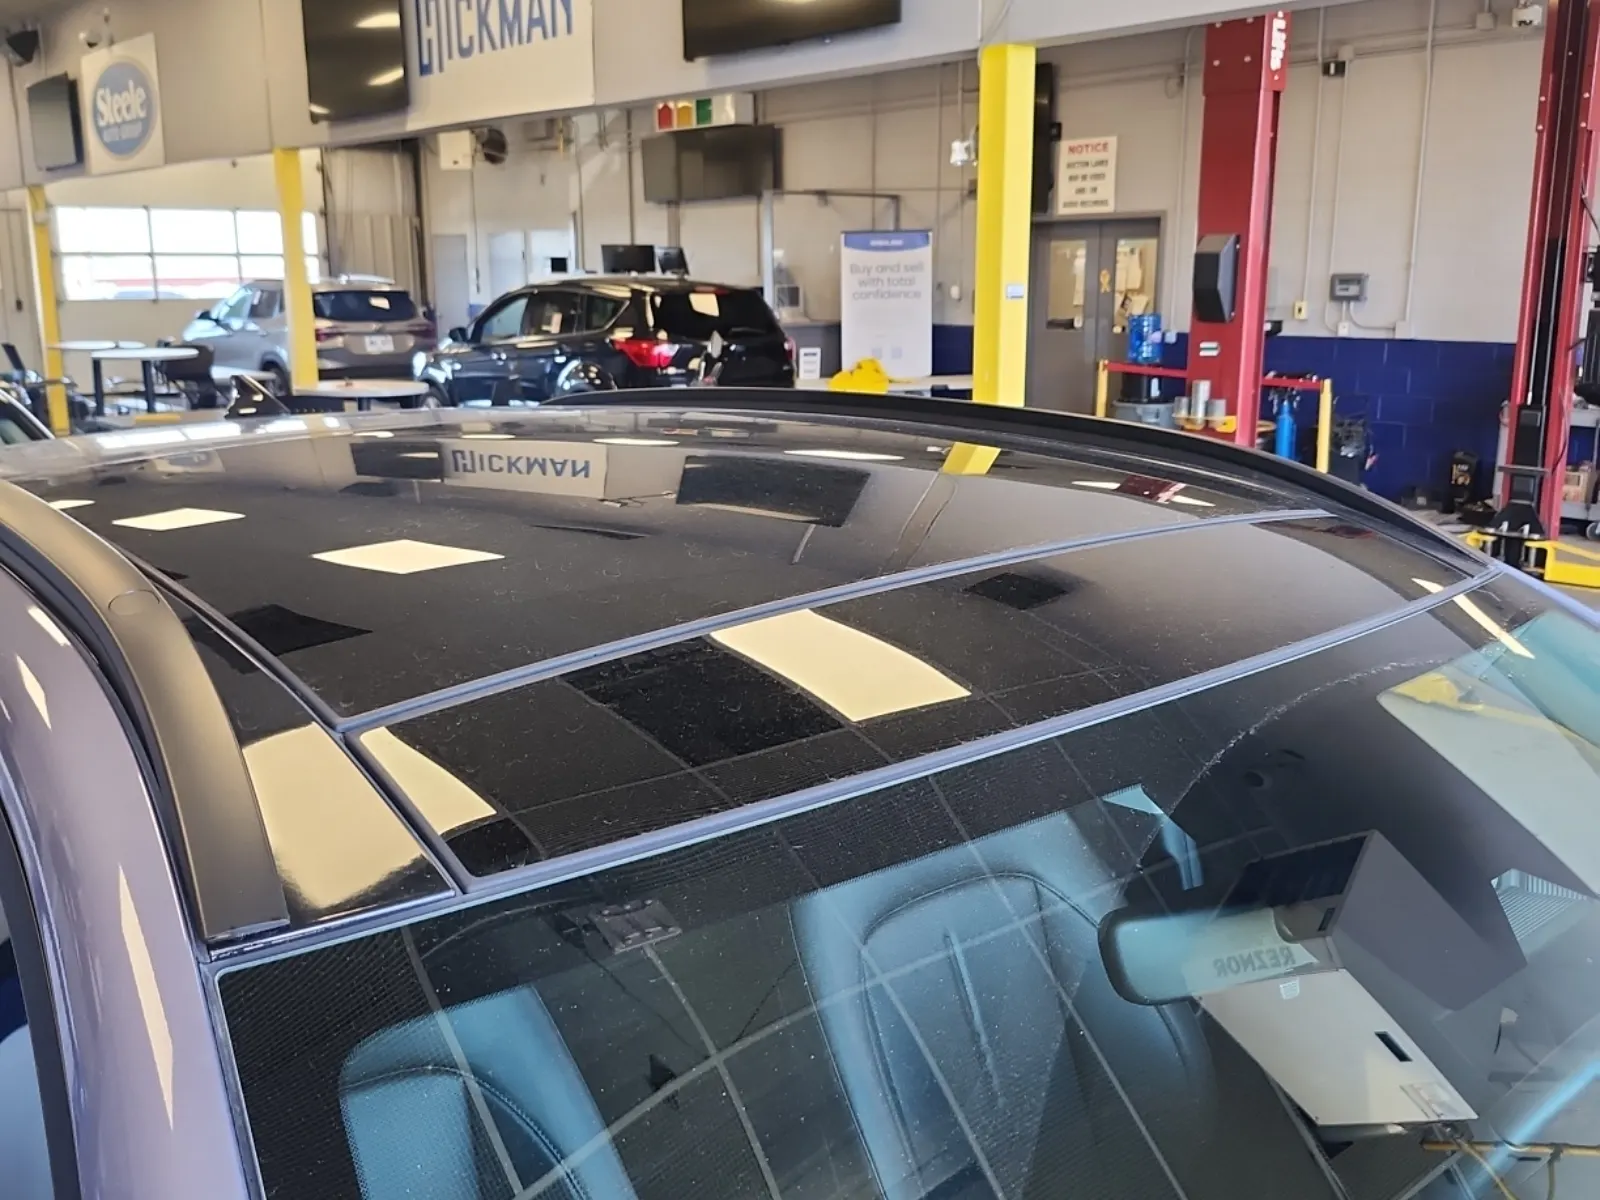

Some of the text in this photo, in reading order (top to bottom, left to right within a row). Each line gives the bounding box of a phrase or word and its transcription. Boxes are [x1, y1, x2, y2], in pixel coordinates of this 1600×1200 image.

[95, 79, 147, 128] Steele
[1068, 142, 1109, 155] NOTICE
[850, 262, 924, 276] Buy and sell
[858, 276, 916, 288] with total
[852, 288, 922, 300] confidence
